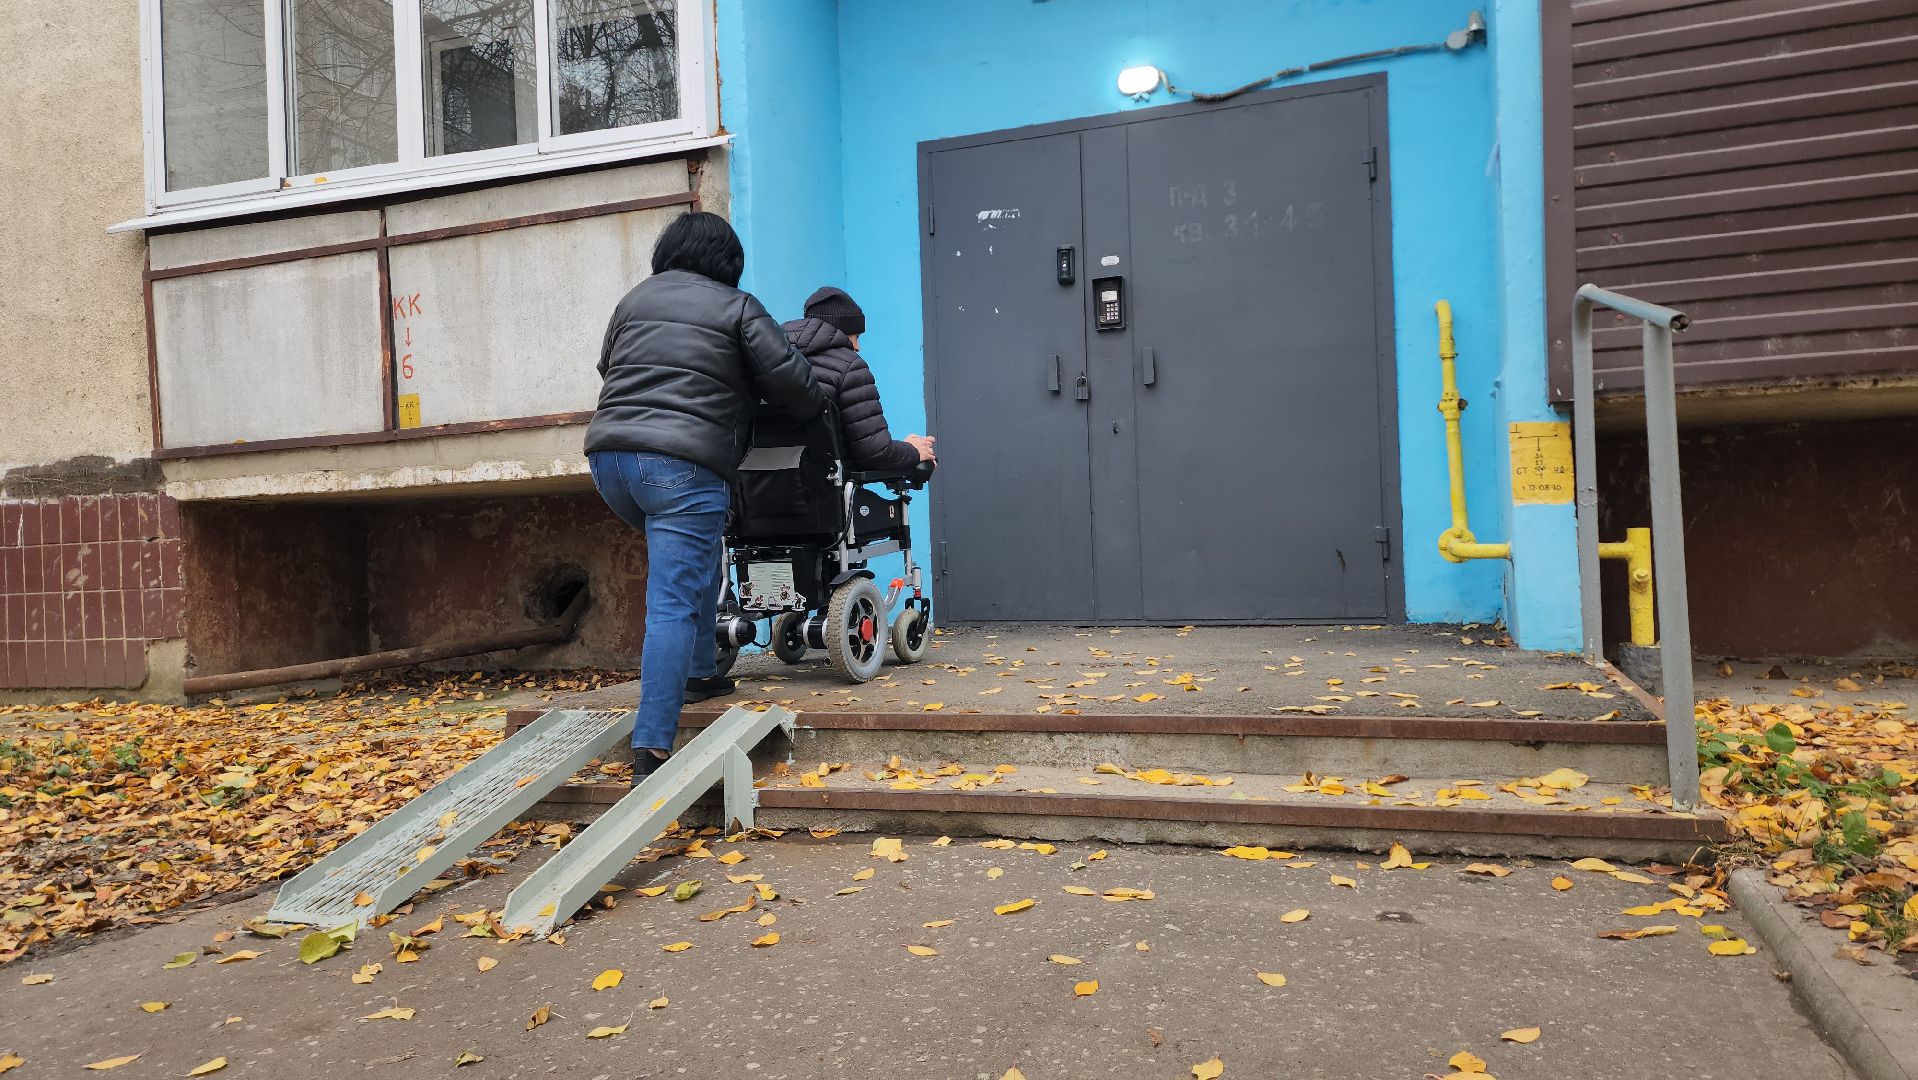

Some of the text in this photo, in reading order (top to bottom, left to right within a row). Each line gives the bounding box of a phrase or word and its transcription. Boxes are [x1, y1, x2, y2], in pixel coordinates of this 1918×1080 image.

[1222, 180, 1237, 206] 3
[393, 292, 422, 321] КК
[402, 353, 414, 380] 6
